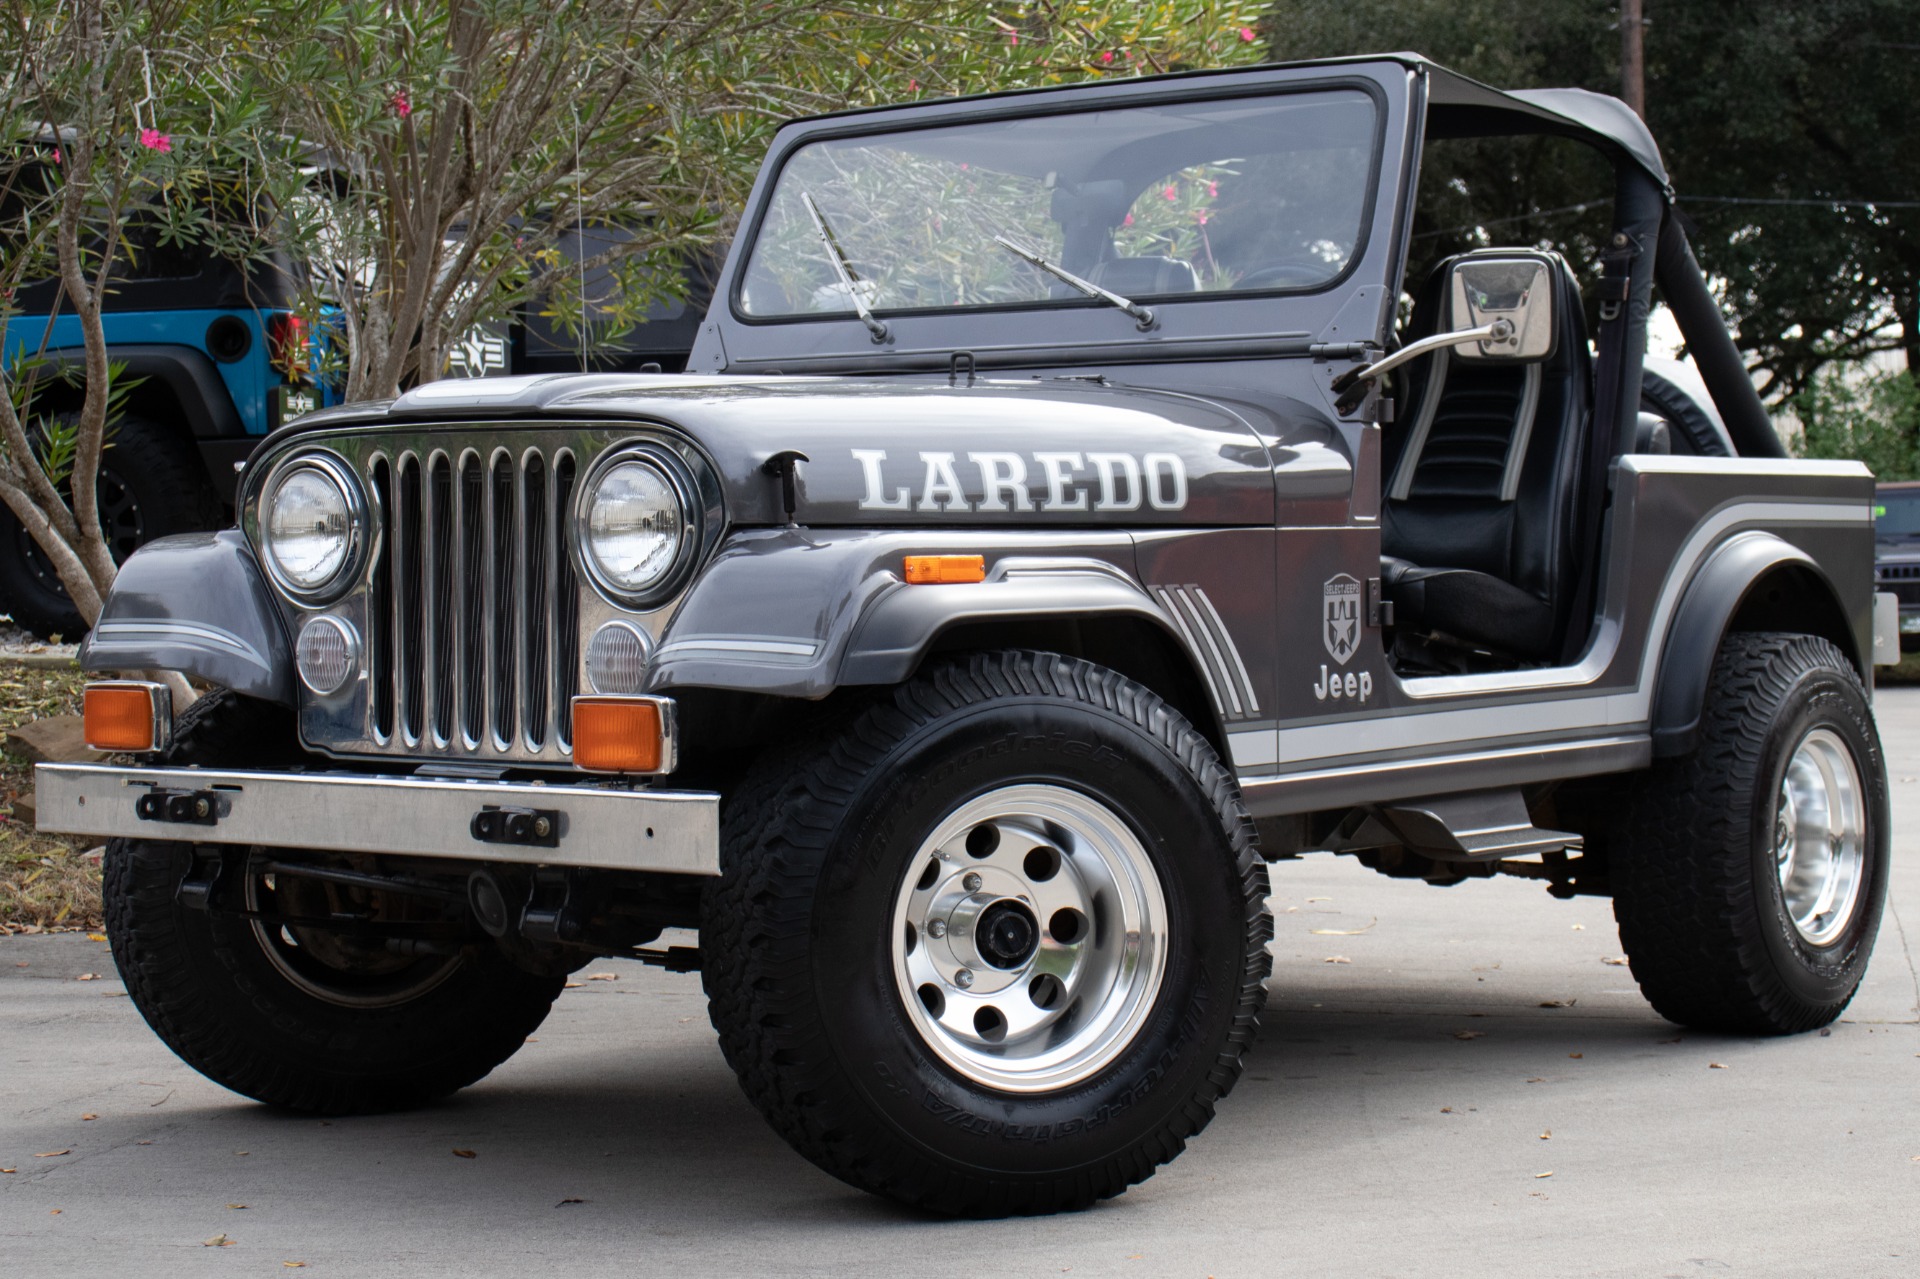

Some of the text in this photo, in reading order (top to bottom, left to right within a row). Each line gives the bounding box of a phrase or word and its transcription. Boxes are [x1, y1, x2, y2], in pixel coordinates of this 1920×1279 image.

[851, 449, 1188, 512] LAREDO
[1325, 584, 1359, 595] SELECT JEEPS
[1314, 665, 1372, 702] Jeep
